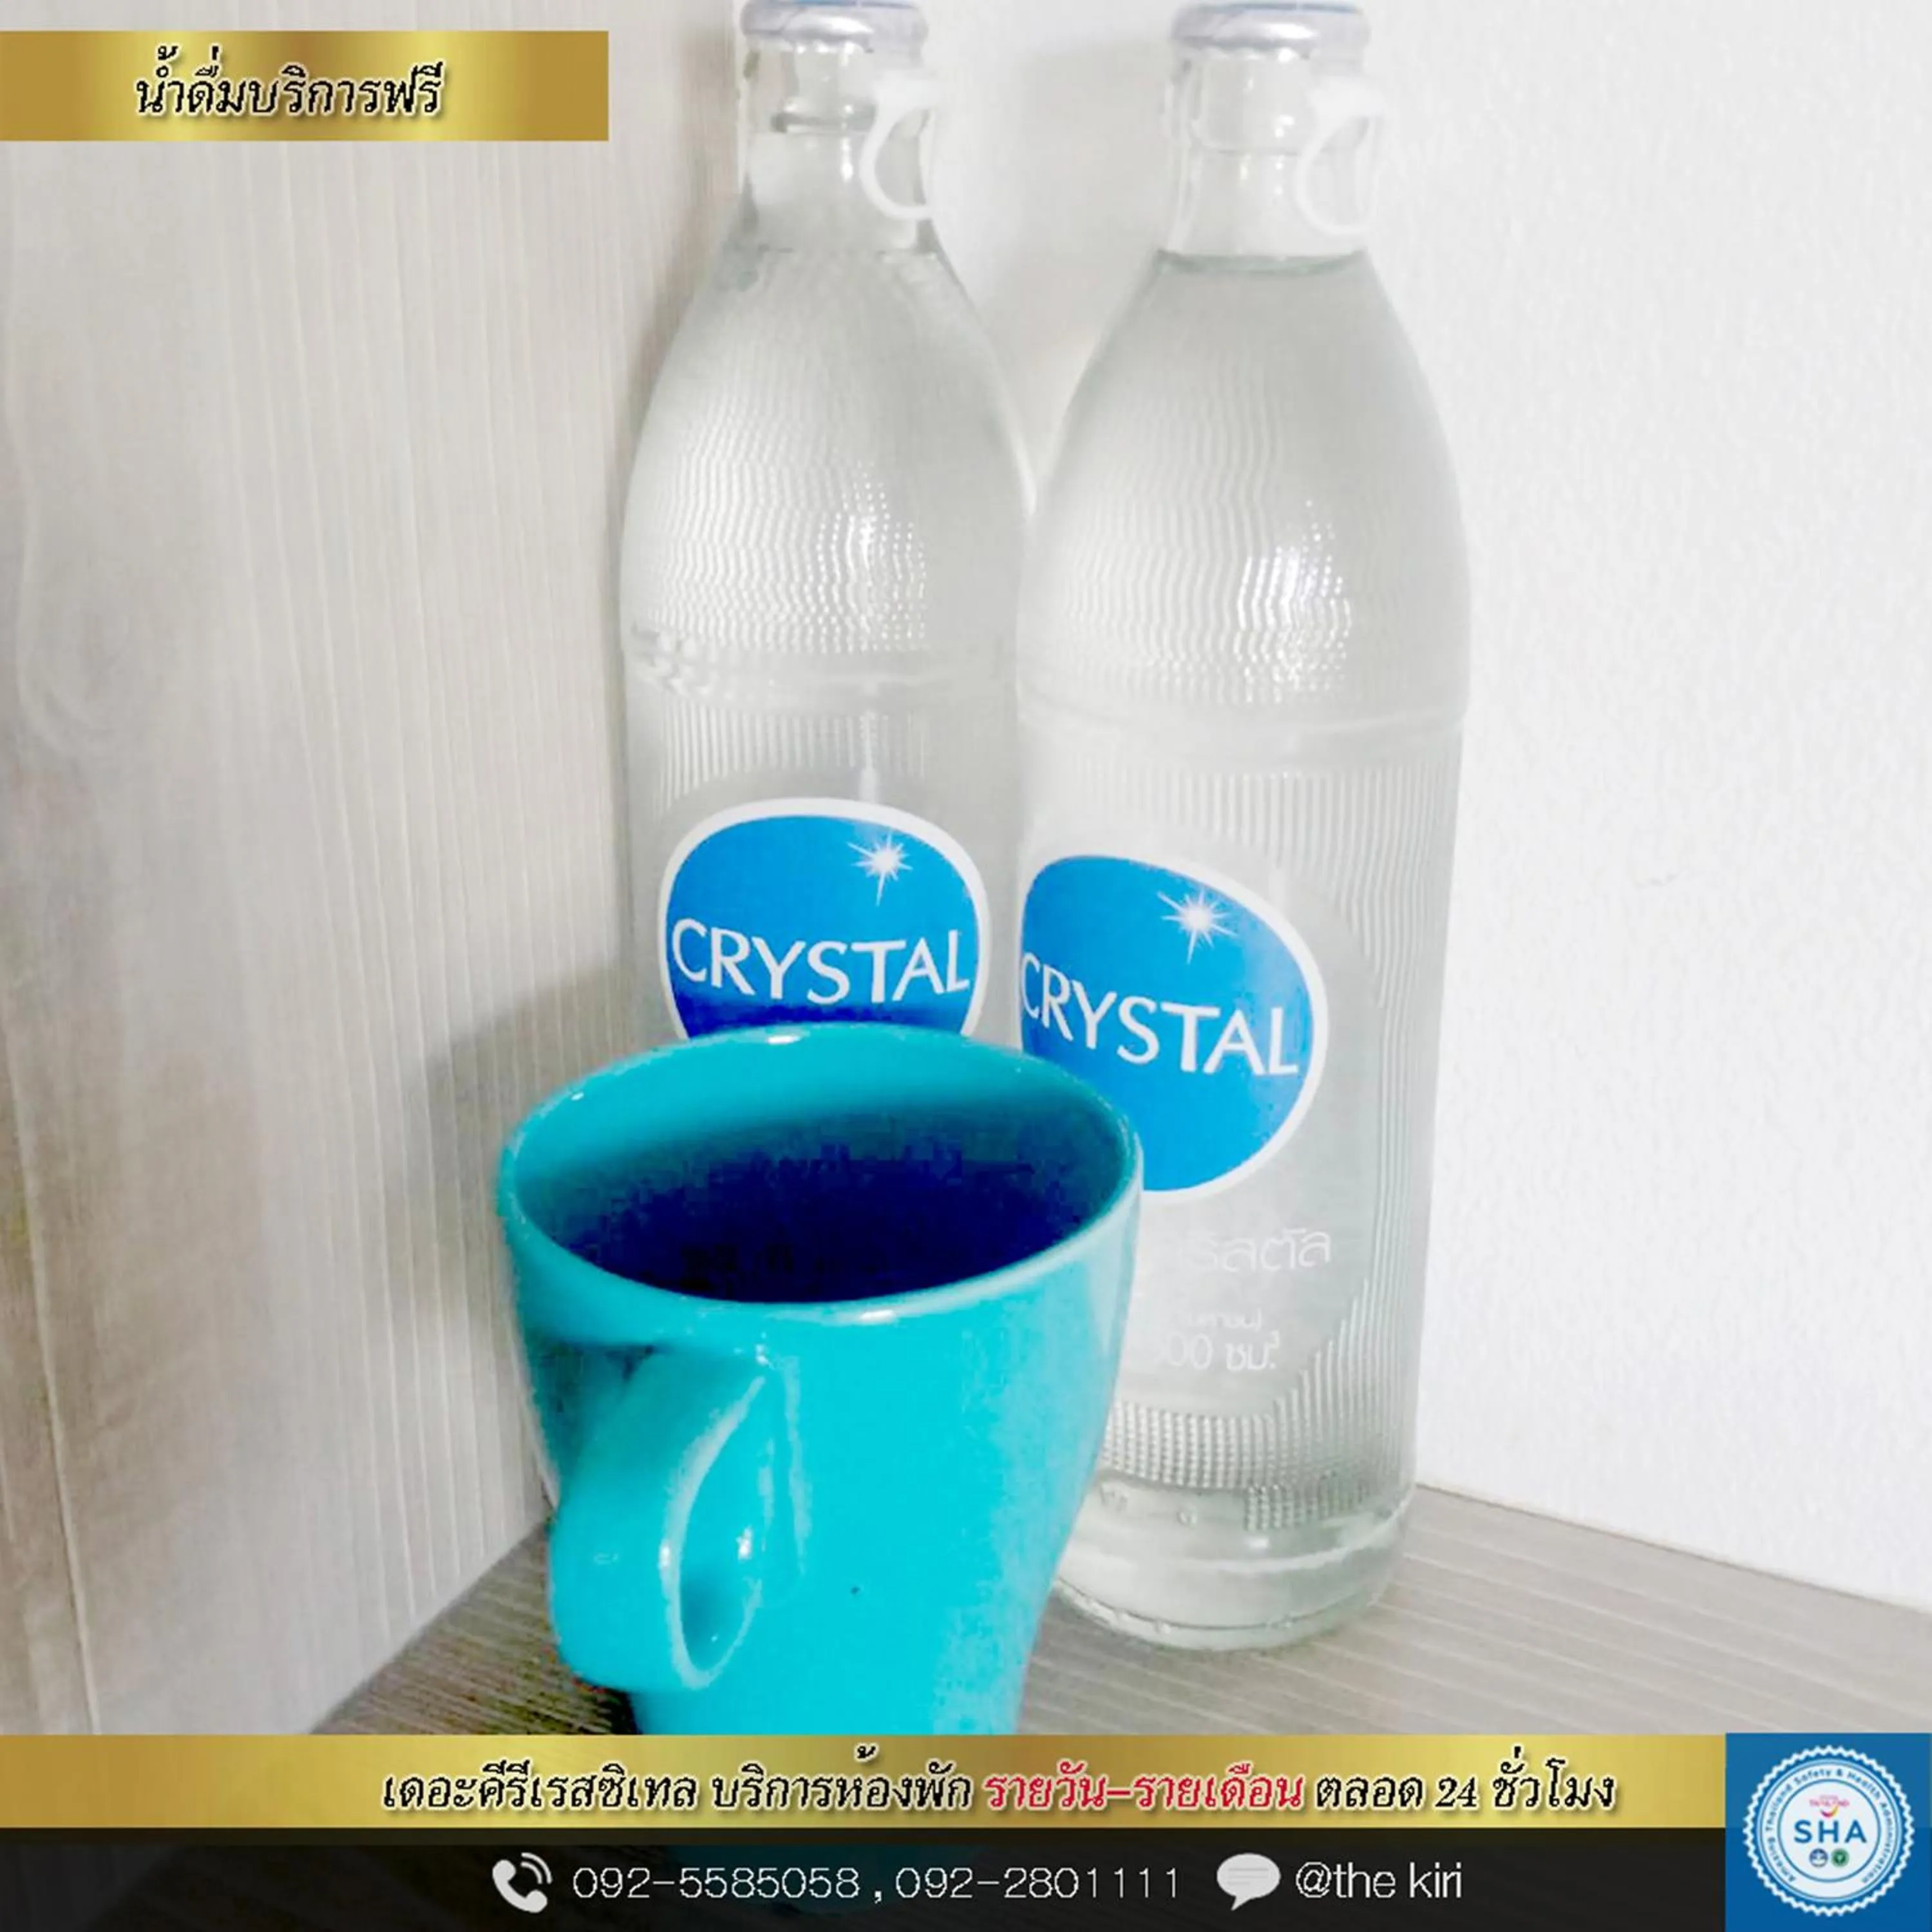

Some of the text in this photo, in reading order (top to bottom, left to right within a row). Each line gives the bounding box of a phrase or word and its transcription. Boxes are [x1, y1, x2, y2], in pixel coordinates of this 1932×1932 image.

[672, 918, 971, 1005] CRYSTAL
[1021, 952, 1300, 1076] CRYSTAL
[1157, 1332, 1214, 1370] 00
